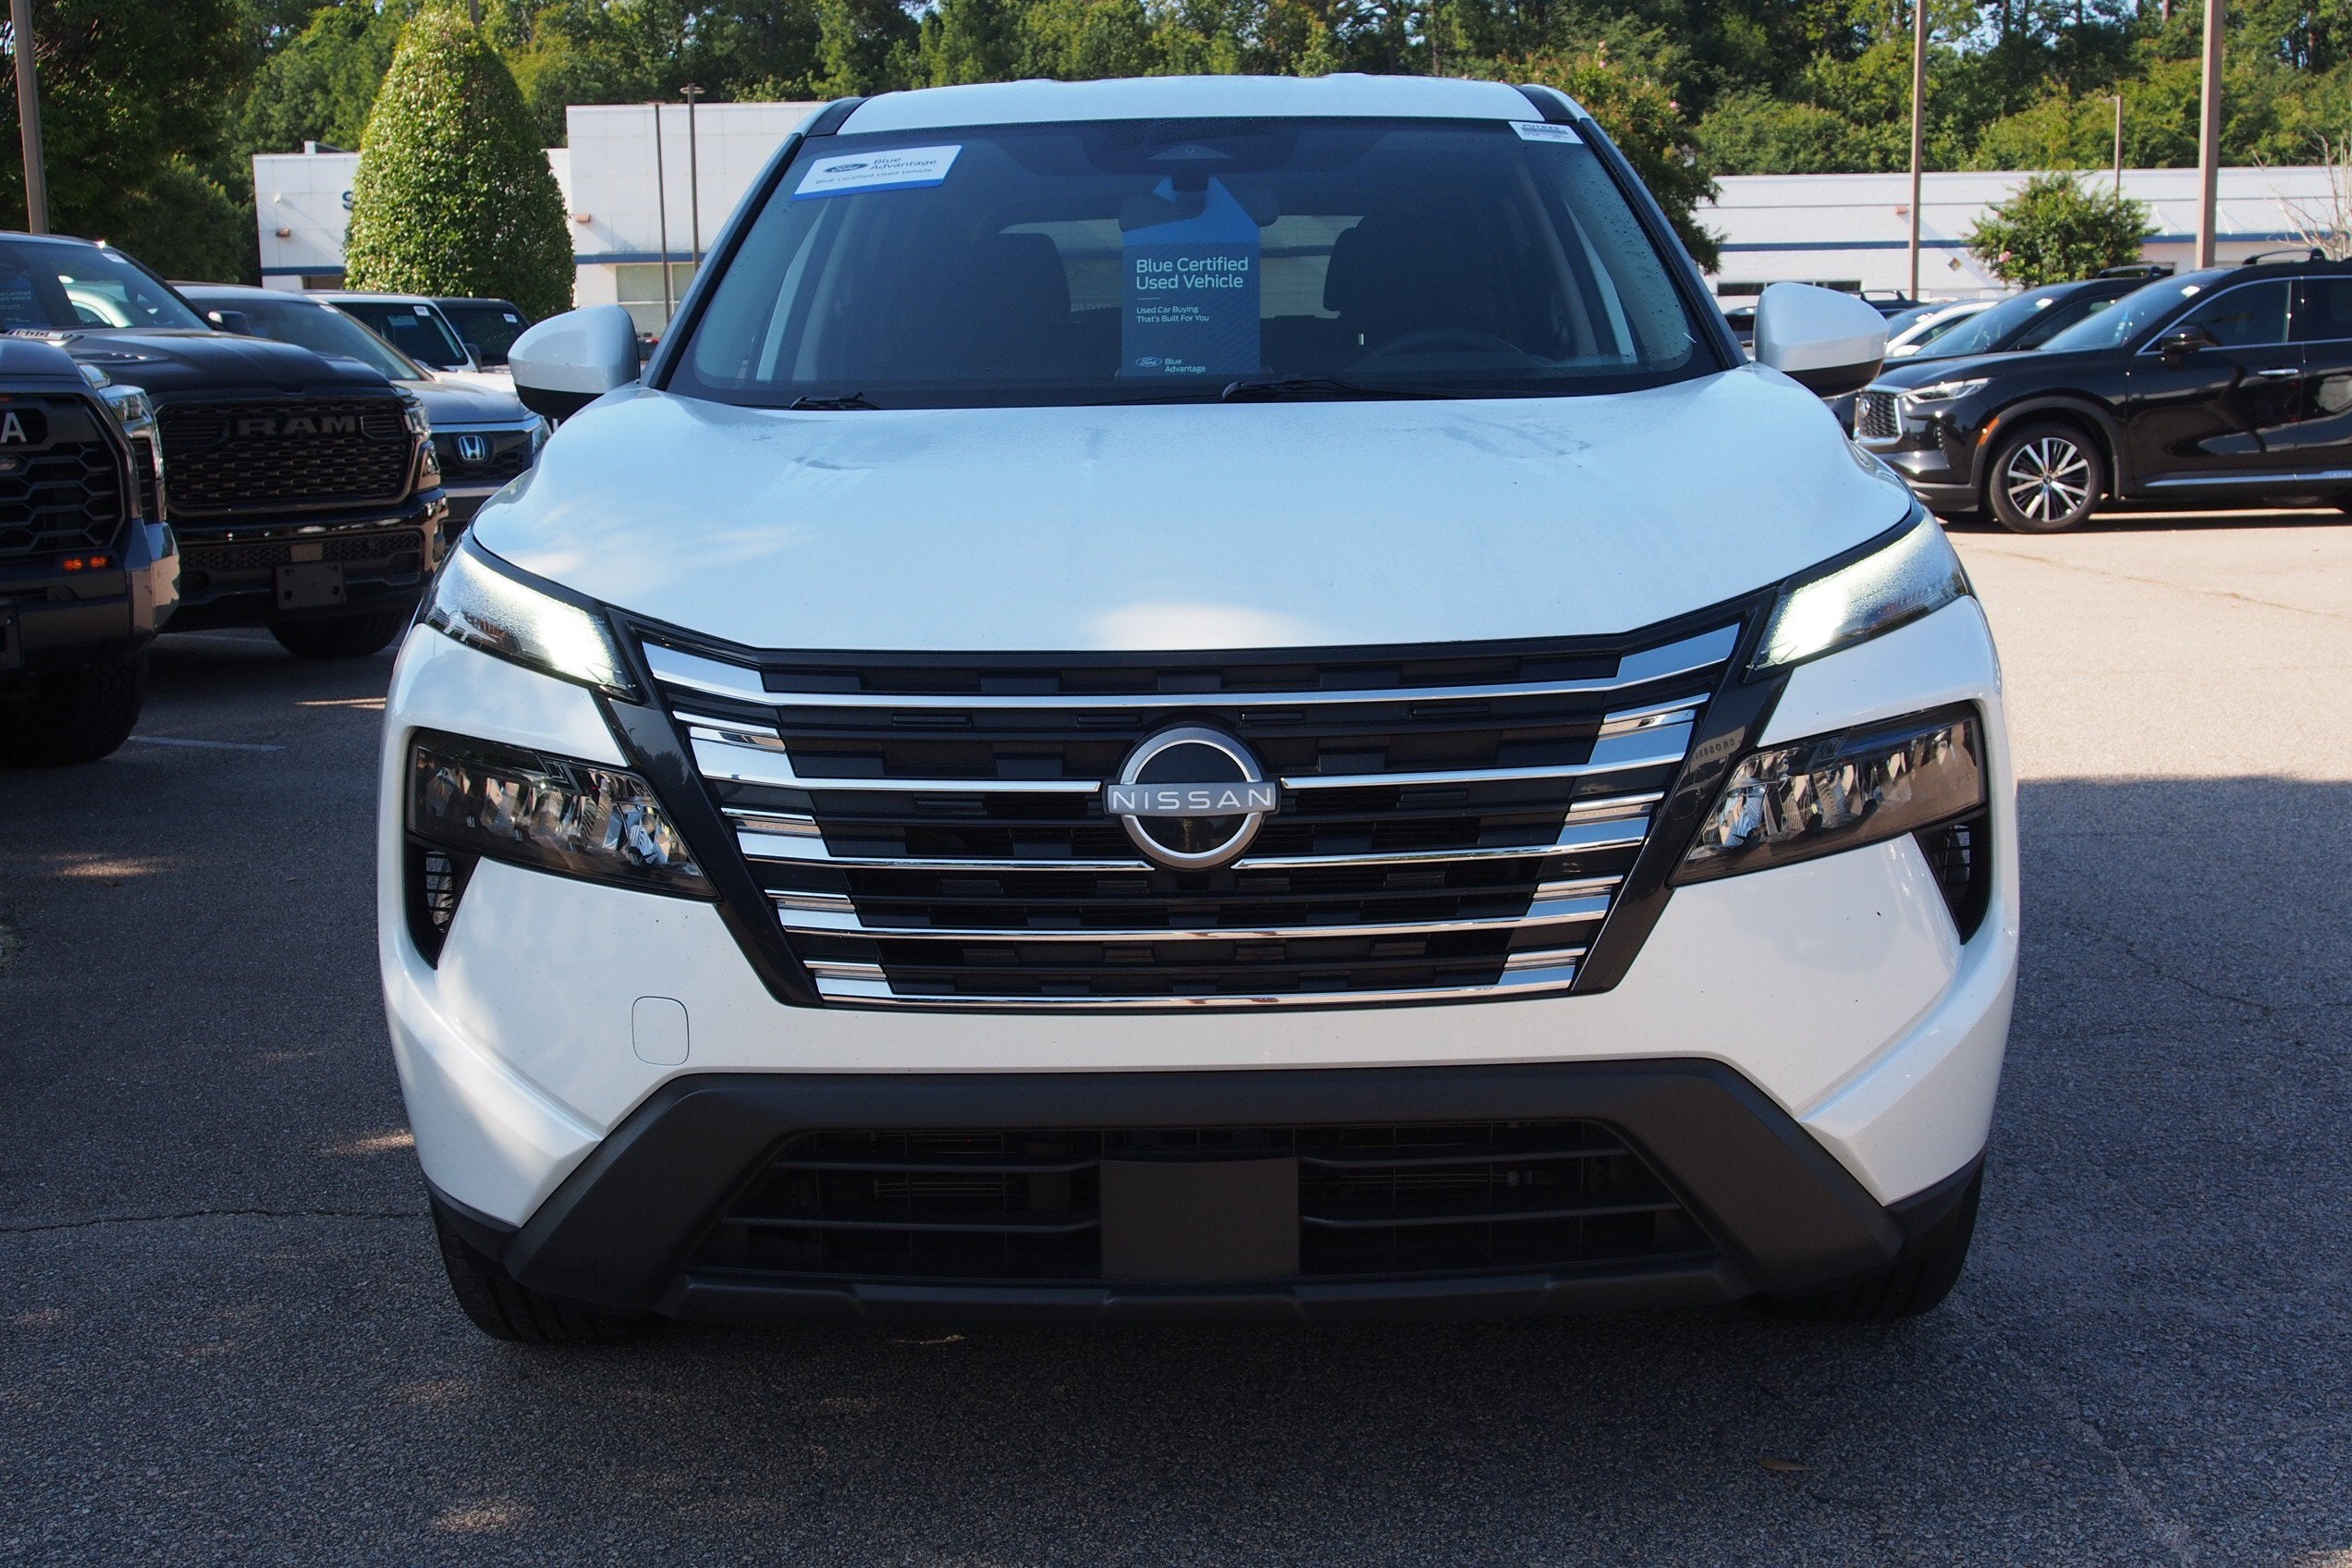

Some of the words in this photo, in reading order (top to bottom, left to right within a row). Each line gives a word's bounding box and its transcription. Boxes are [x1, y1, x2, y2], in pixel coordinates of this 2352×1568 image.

[869, 159, 937, 170] Advantage
[838, 173, 875, 182] Certified
[1136, 258, 1173, 274] Blue
[1176, 256, 1249, 272] Certified
[1136, 274, 1179, 290] Used
[1182, 273, 1243, 288] Vehicle
[1136, 306, 1157, 314] Used
[1172, 305, 1198, 314] Buying
[1161, 314, 1179, 323] Built
[1165, 365, 1207, 374] Advantage
[237, 415, 356, 435] RAM
[1111, 788, 1272, 810] NISSAN
